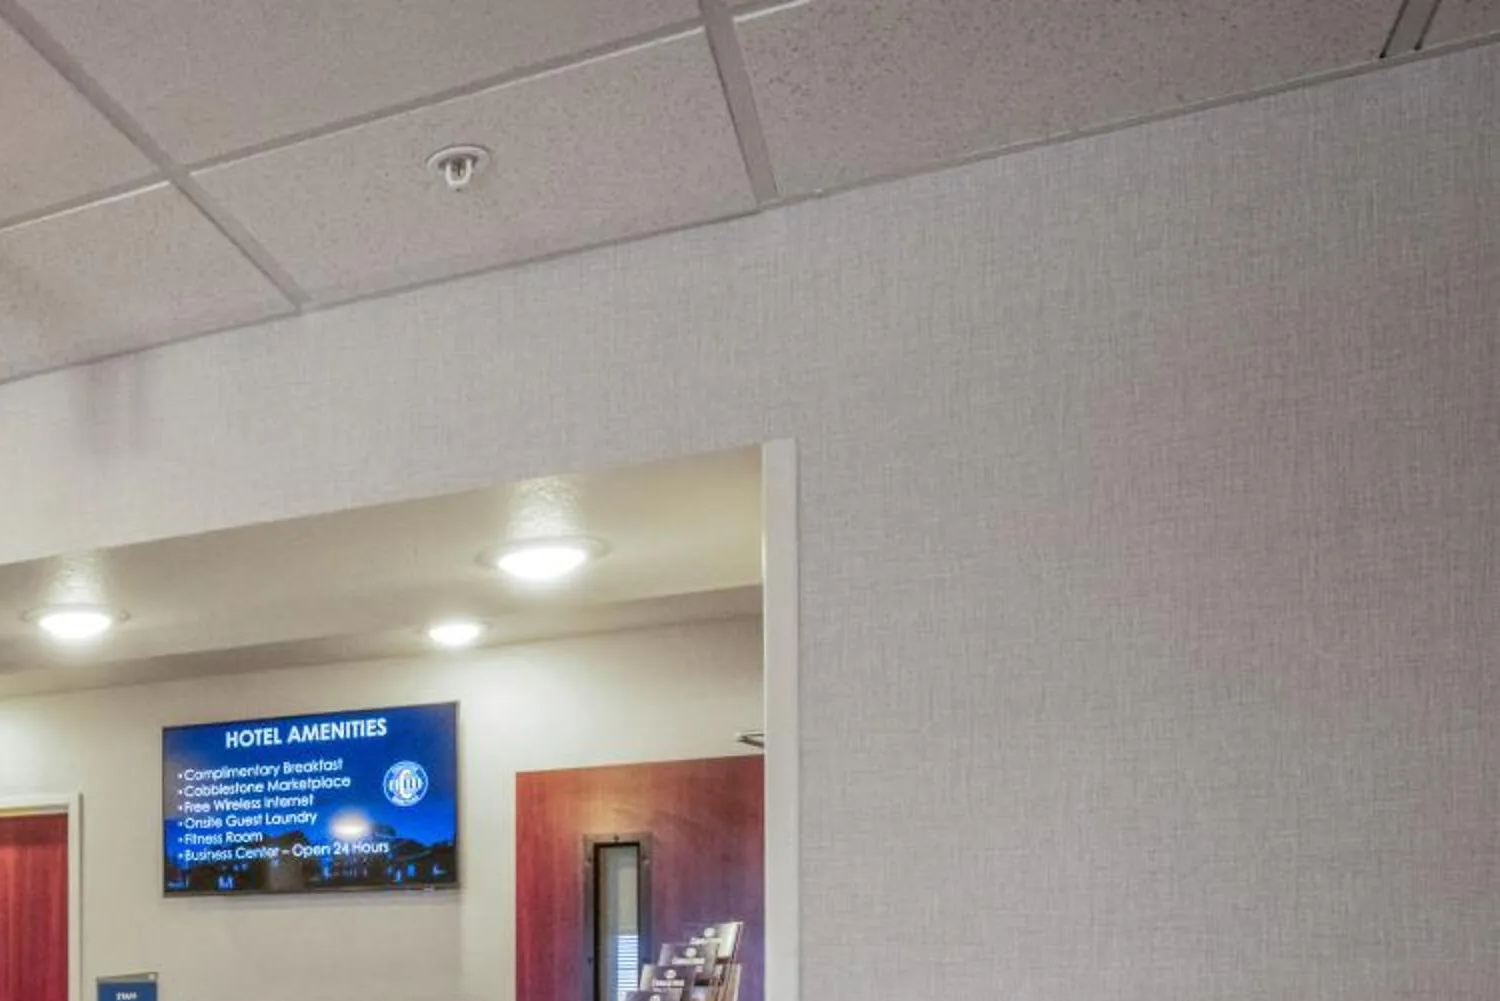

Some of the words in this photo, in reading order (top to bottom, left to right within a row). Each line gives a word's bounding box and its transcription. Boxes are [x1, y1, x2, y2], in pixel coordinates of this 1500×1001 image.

[225, 727, 283, 749] HOTEL
[287, 717, 388, 743] AMENITIES
[183, 763, 281, 781] Complimentary
[283, 757, 343, 774] Breakfast
[183, 781, 265, 797] Cobblestone
[267, 775, 351, 792] Marketplace
[183, 801, 211, 815] Free
[213, 797, 262, 812] Wireless
[263, 793, 314, 809] Internet
[183, 815, 223, 830] Onsite
[225, 812, 263, 828] Guest
[265, 811, 318, 826] Laundry
[183, 832, 223, 846] Fitness
[225, 830, 263, 844] Room
[183, 847, 233, 862] Business
[235, 845, 280, 860] Center
[291, 842, 331, 859] Open
[333, 841, 349, 856] 24
[352, 840, 390, 856] Hours
